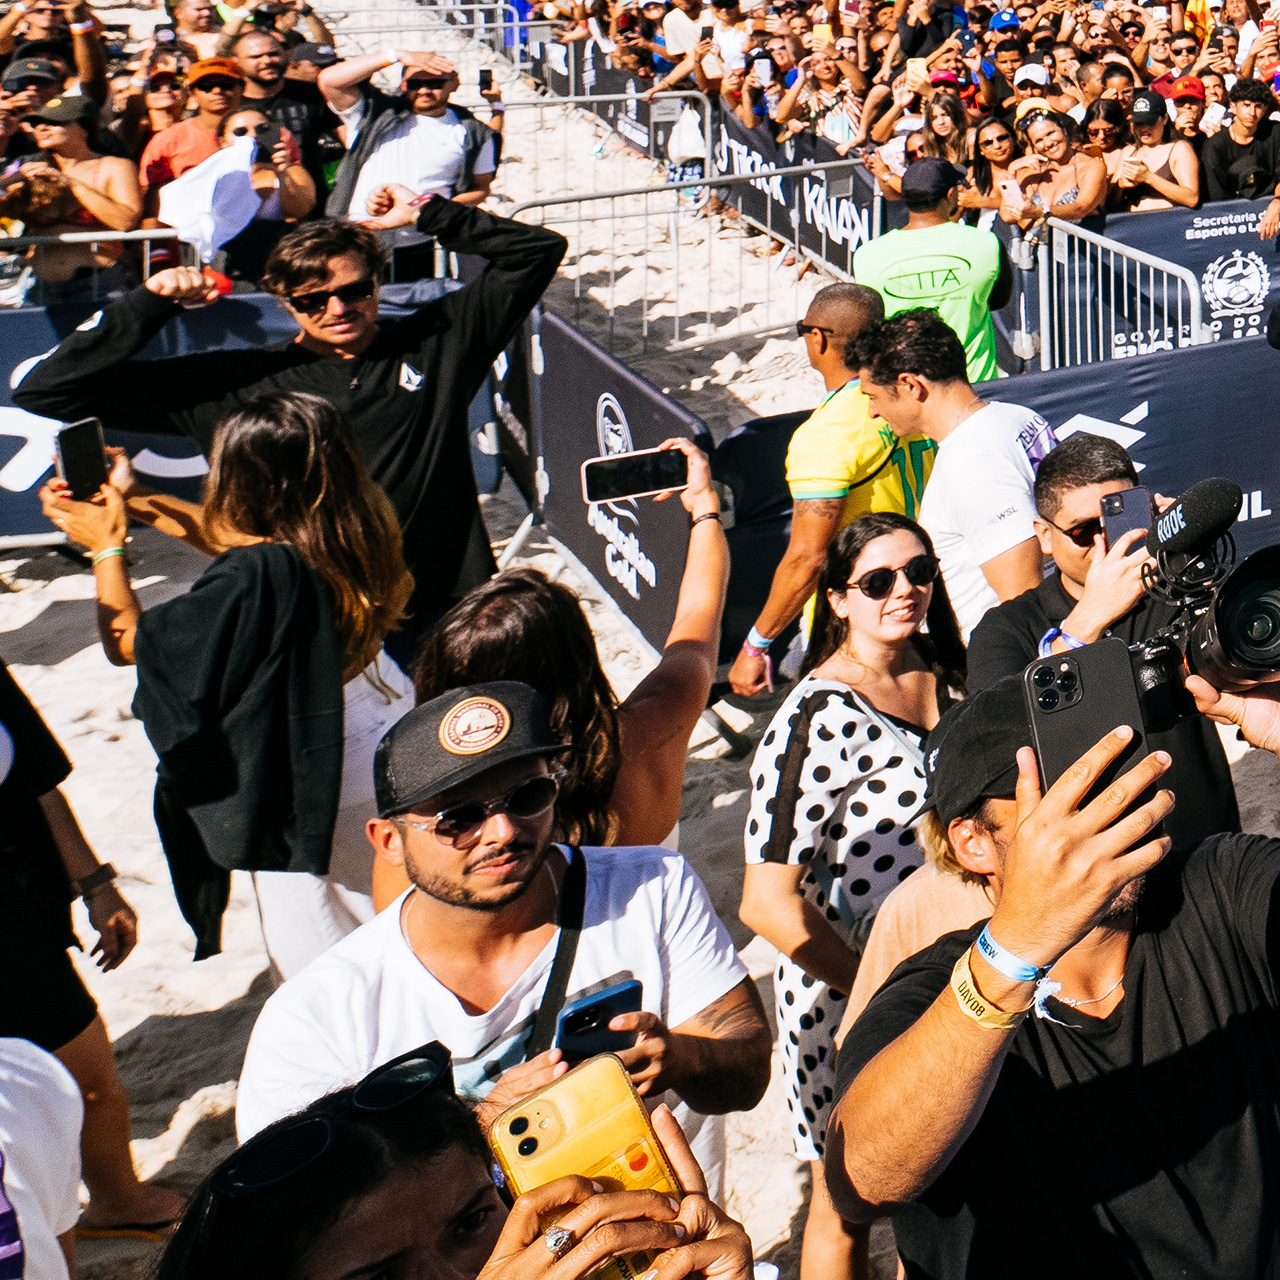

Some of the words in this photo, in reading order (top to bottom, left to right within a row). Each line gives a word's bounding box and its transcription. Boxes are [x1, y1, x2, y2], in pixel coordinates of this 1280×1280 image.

[1185, 225, 1237, 240] Esporte
[1238, 224, 1247, 234] e
[1193, 212, 1257, 228] Secretaria
[1114, 320, 1223, 345] GOVERO
[979, 933, 999, 959] CREW
[957, 980, 986, 1017] DAY08
